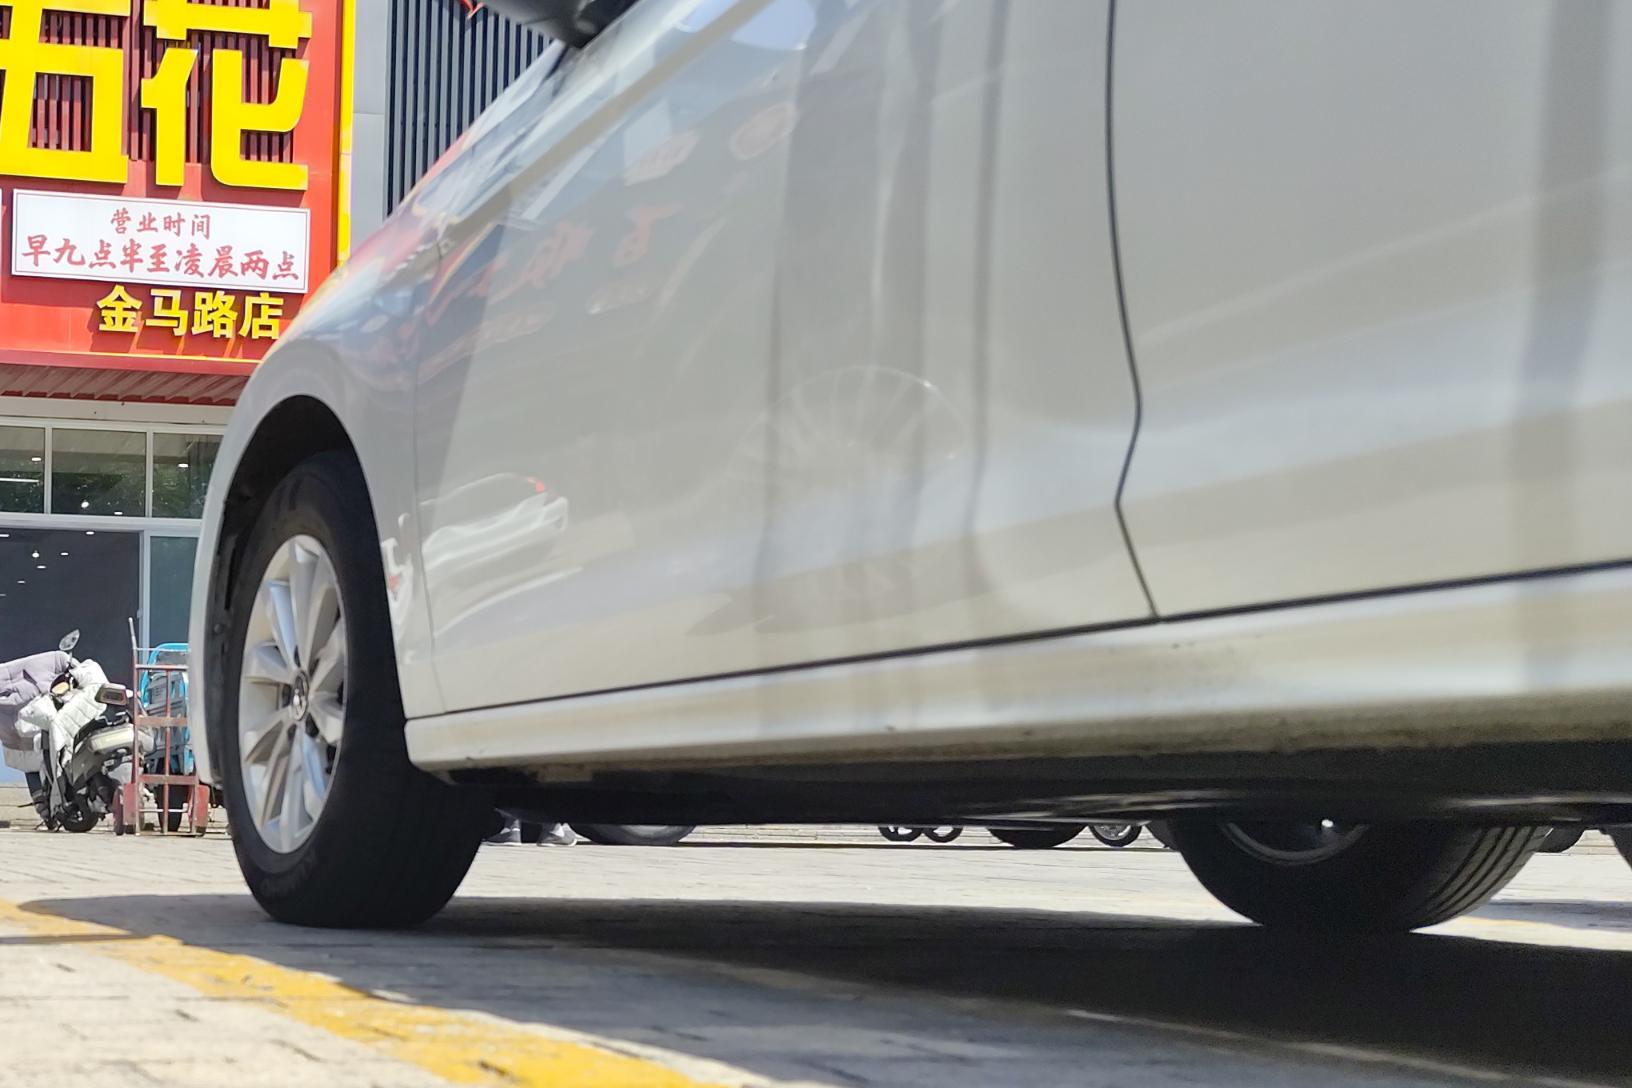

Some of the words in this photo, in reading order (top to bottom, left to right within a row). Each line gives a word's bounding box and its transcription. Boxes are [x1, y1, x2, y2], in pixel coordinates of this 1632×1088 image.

[110, 207, 211, 240] 营业时间
[21, 233, 300, 281] 早九点半至凌晨两点
[97, 285, 284, 340] 金马路店
